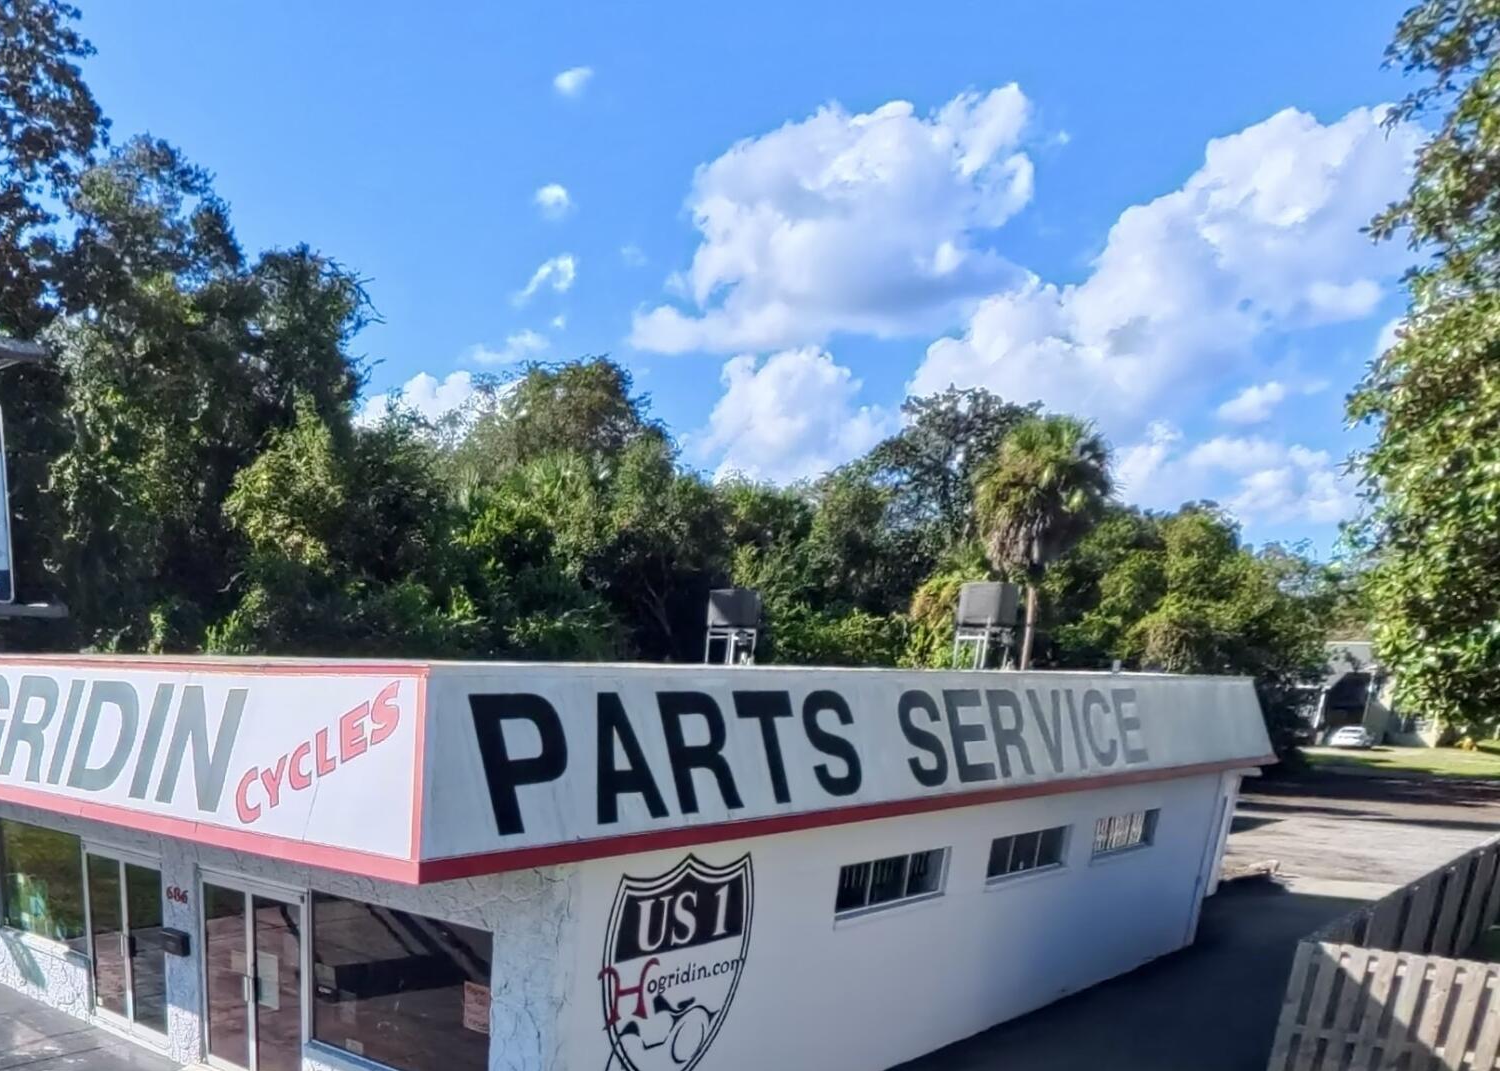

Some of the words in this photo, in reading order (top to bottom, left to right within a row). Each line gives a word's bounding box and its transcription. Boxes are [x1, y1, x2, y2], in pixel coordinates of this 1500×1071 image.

[235, 680, 402, 826] CYCLES
[468, 689, 862, 837] PARTS
[898, 686, 1149, 787] SERVICE
[166, 886, 188, 905] 686
[637, 890, 698, 951] US
[712, 883, 730, 937] 1
[598, 956, 745, 1027] Hogridin.com
